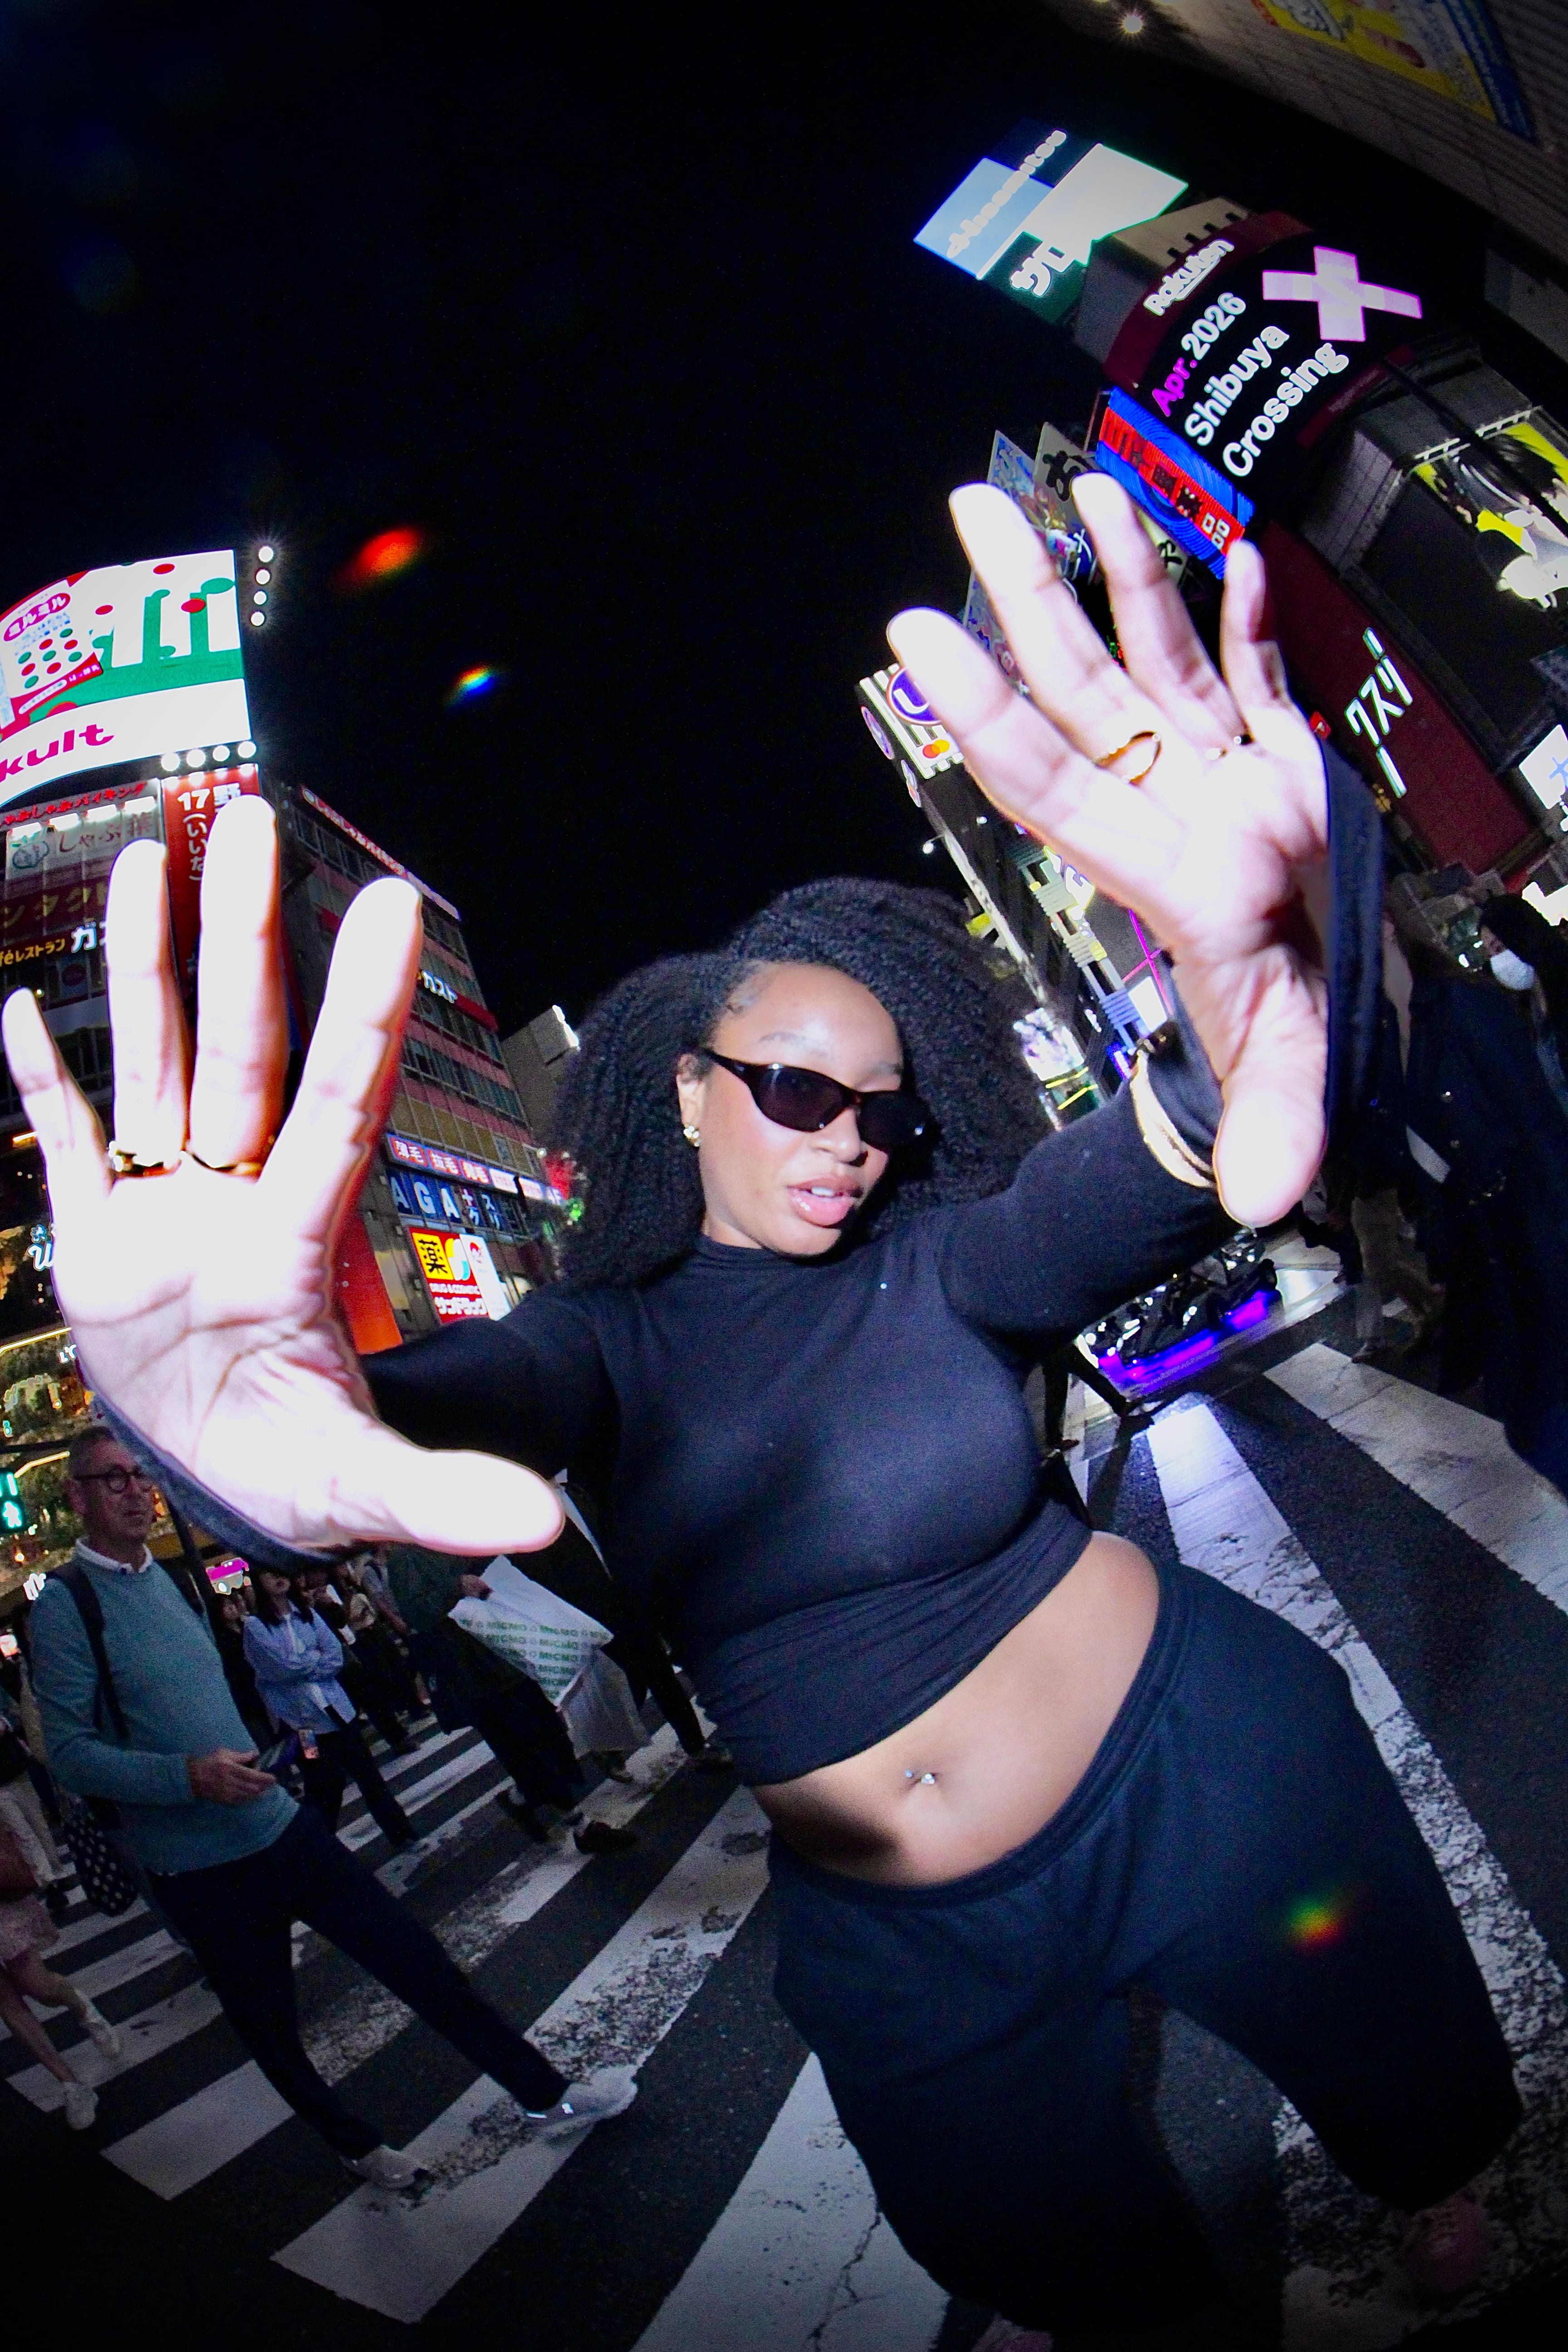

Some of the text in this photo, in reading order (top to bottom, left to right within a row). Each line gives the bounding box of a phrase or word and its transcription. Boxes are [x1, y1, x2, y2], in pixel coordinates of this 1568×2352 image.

[1144, 240, 1234, 315] Rakuten
[1152, 357, 1197, 416] Apr.
[1181, 293, 1246, 360] 2026
[1185, 326, 1290, 446] Shibuya
[1223, 343, 1349, 476] Crossing
[391, 1176, 460, 1219] AGA
[419, 1239, 448, 1274] 薬
